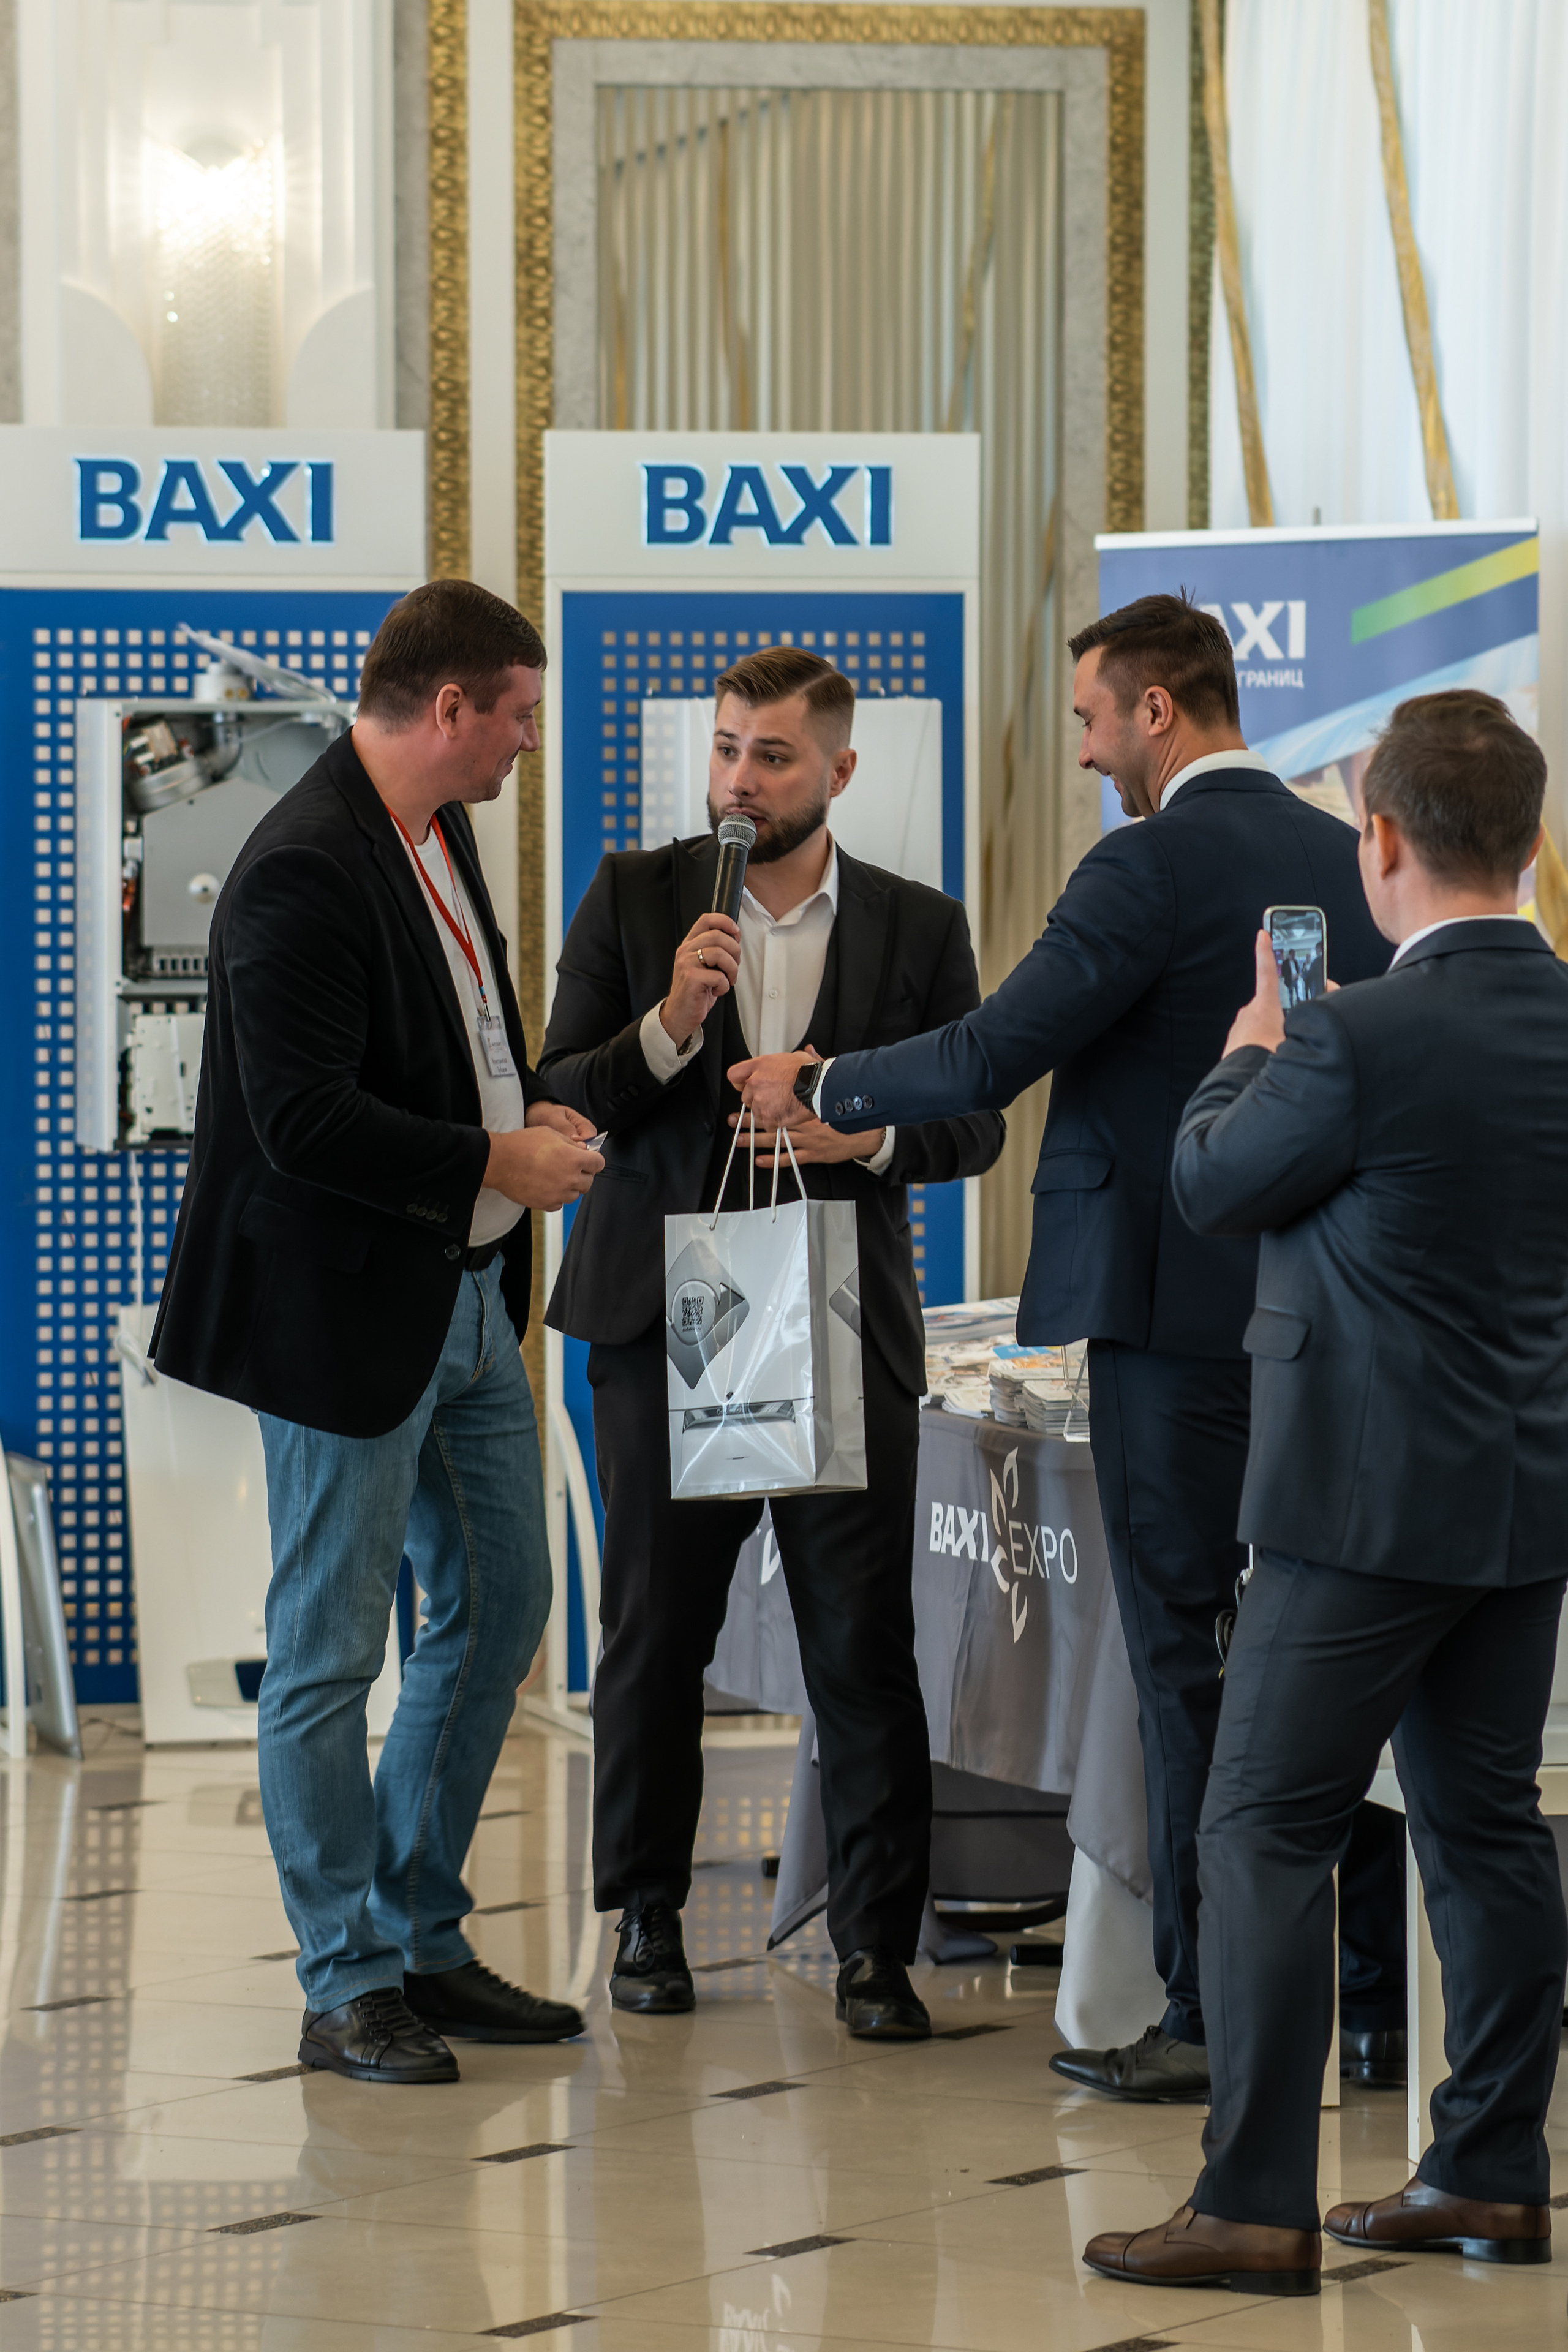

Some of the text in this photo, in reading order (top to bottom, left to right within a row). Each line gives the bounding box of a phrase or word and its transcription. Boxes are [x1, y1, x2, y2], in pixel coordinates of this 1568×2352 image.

[74, 459, 334, 542] BAXI
[641, 464, 892, 545] BAXI
[1199, 600, 1306, 660] XI
[1237, 669, 1305, 689] ГРАНИЦ
[929, 1501, 1078, 1585] BAXI EXPO
